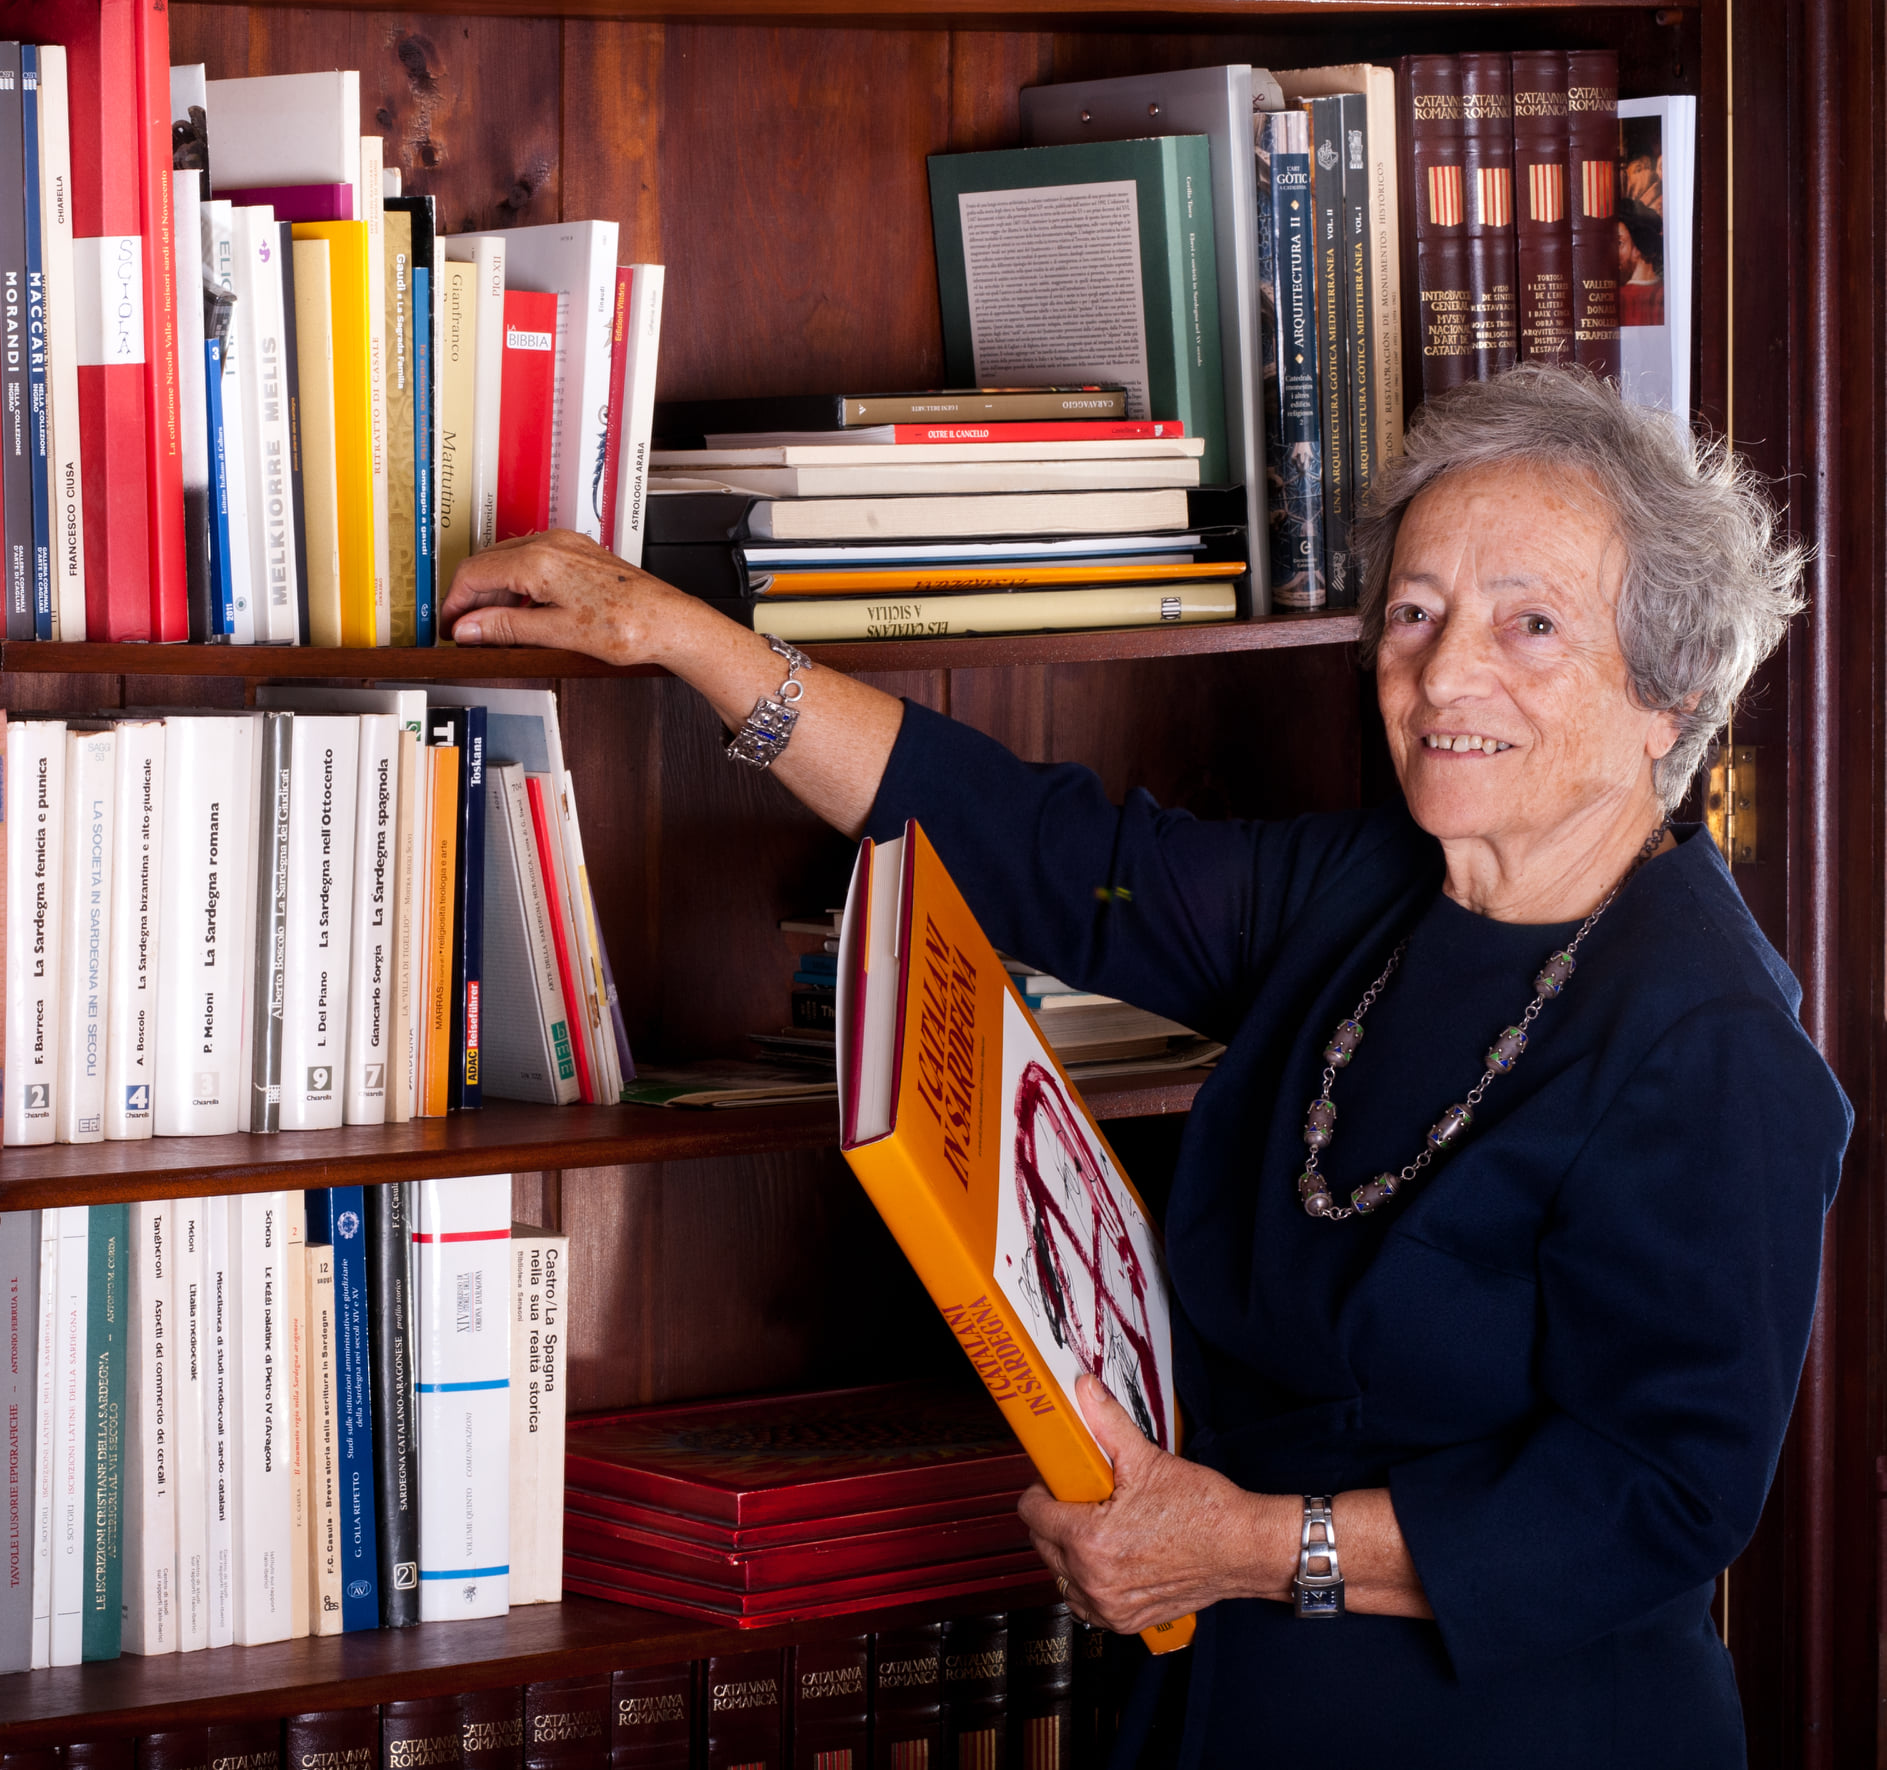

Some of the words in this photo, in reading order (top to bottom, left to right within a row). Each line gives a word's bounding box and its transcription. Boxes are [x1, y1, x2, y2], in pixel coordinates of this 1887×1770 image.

[57, 175, 65, 225] CHIARELLA
[1290, 216, 1301, 228] II
[1326, 218, 1334, 240] VOL.
[493, 256, 501, 274] XII
[117, 239, 133, 355] SCIOLA
[492, 276, 500, 297] PIO
[1291, 231, 1305, 348] ARQUITECTURA
[1325, 248, 1337, 341] MEDITERRÁNEA
[6, 271, 20, 373] MORANDI
[30, 271, 44, 373] MACCARI
[450, 274, 463, 362] Gianfranco
[507, 323, 517, 332] LA
[508, 333, 550, 349] BIBBIA
[371, 337, 380, 383] CASALE
[1326, 345, 1338, 390] GÓTICA
[262, 337, 279, 422] MELIS
[372, 384, 380, 402] DI
[1062, 399, 1114, 409] CARAVAGGIO
[372, 408, 382, 475] RITRATTO
[928, 429, 948, 439] OLTRE
[954, 428, 989, 439] CANCELLO
[1329, 393, 1341, 485] ARQUITECTURA
[636, 442, 645, 471] ARABA
[66, 462, 75, 498] CIUSA
[440, 429, 457, 529] Mattutino
[631, 476, 642, 532] ASTROLOGIA
[1332, 488, 1342, 514] UNA
[266, 440, 287, 606] MELKIORRE
[483, 491, 494, 548] Schneider
[67, 504, 77, 577] FRANCESCO
[867, 604, 911, 621] SICÍLIA
[914, 605, 922, 619] A
[927, 622, 949, 637] ELS
[470, 737, 482, 787] Toskana
[36, 757, 49, 809] punica
[376, 758, 390, 826] spagnola
[38, 812, 46, 823] e
[93, 800, 103, 820] LA
[320, 748, 334, 855] nell'Ottocento
[207, 802, 220, 866] romana
[34, 828, 46, 878] fenicia
[91, 823, 103, 888] SOCIETÀ
[373, 831, 388, 903] Sardegna
[91, 891, 101, 904] IN
[204, 872, 220, 943] Sardegna
[319, 859, 333, 927] Sardegna
[33, 882, 47, 954] Sardegna
[372, 908, 383, 926] La
[89, 908, 101, 990] SARDEGNA
[319, 931, 329, 948] La
[33, 959, 44, 977] La
[204, 949, 216, 967] La
[372, 944, 384, 984] Sorgia
[88, 995, 98, 1018] NEI
[318, 971, 328, 1007] Piano
[918, 911, 950, 1103] CATALANI
[35, 999, 44, 1052] Barreca
[203, 992, 214, 1038] Meloni
[318, 1010, 328, 1032] Del
[370, 987, 382, 1047] Giancarlo
[467, 984, 478, 1047] Reiseführer
[86, 1024, 98, 1077] SECOLI
[202, 1047, 213, 1057] P.
[317, 1036, 327, 1047] L.
[944, 943, 977, 1147] SARDEGNA
[34, 1055, 44, 1065] F.
[365, 1064, 383, 1088] 7
[468, 1051, 478, 1081] ADAC
[30, 1084, 46, 1108] 2
[312, 1067, 329, 1090] 9
[127, 1085, 149, 1110] 4
[917, 1079, 942, 1127] I
[943, 1120, 970, 1194] IN
[264, 1209, 273, 1248] Schena
[265, 1266, 273, 1278] Le
[319, 1262, 329, 1273] 12
[341, 1258, 351, 1302] giudiziarie
[530, 1249, 542, 1286] nella
[216, 1271, 225, 1333] Miscellanea
[263, 1280, 273, 1306] leggi
[352, 1287, 360, 1299] XV
[530, 1294, 539, 1321] sua
[263, 1308, 273, 1352] palatine
[352, 1308, 361, 1323] XIV
[217, 1335, 226, 1346] di
[321, 1310, 330, 1359] Sardegna
[343, 1311, 354, 1372] amministrative
[353, 1324, 362, 1350] secoli
[529, 1330, 542, 1373] realtà
[941, 1303, 1011, 1391] CATALANI
[967, 1293, 1042, 1394] SARDEGNA
[217, 1348, 226, 1375] studi
[265, 1354, 273, 1365] di
[323, 1361, 330, 1371] in
[354, 1352, 362, 1364] nei
[543, 1334, 558, 1392] Spagna
[265, 1366, 274, 1401] Pietro
[323, 1373, 332, 1417] scrittura
[345, 1374, 355, 1414] istituzioni
[354, 1369, 363, 1405] Sardegna
[995, 1391, 1018, 1402] I
[217, 1377, 227, 1436] medioevali
[265, 1402, 273, 1415] IV
[355, 1408, 364, 1428] della
[528, 1381, 541, 1433] storica
[1025, 1393, 1056, 1416] IN
[263, 1416, 273, 1473] d'Aragona
[324, 1419, 332, 1443] della
[346, 1417, 355, 1436] sulle
[324, 1445, 333, 1475] storia
[346, 1438, 355, 1459] Studi
[325, 1478, 333, 1508] Breve
[353, 1471, 362, 1521] REPETTO
[326, 1518, 334, 1552] Casula
[354, 1523, 362, 1545] OLLA
[354, 1545, 362, 1558] G.
[326, 1558, 334, 1574] F.C.
[397, 1566, 413, 1583] 2
